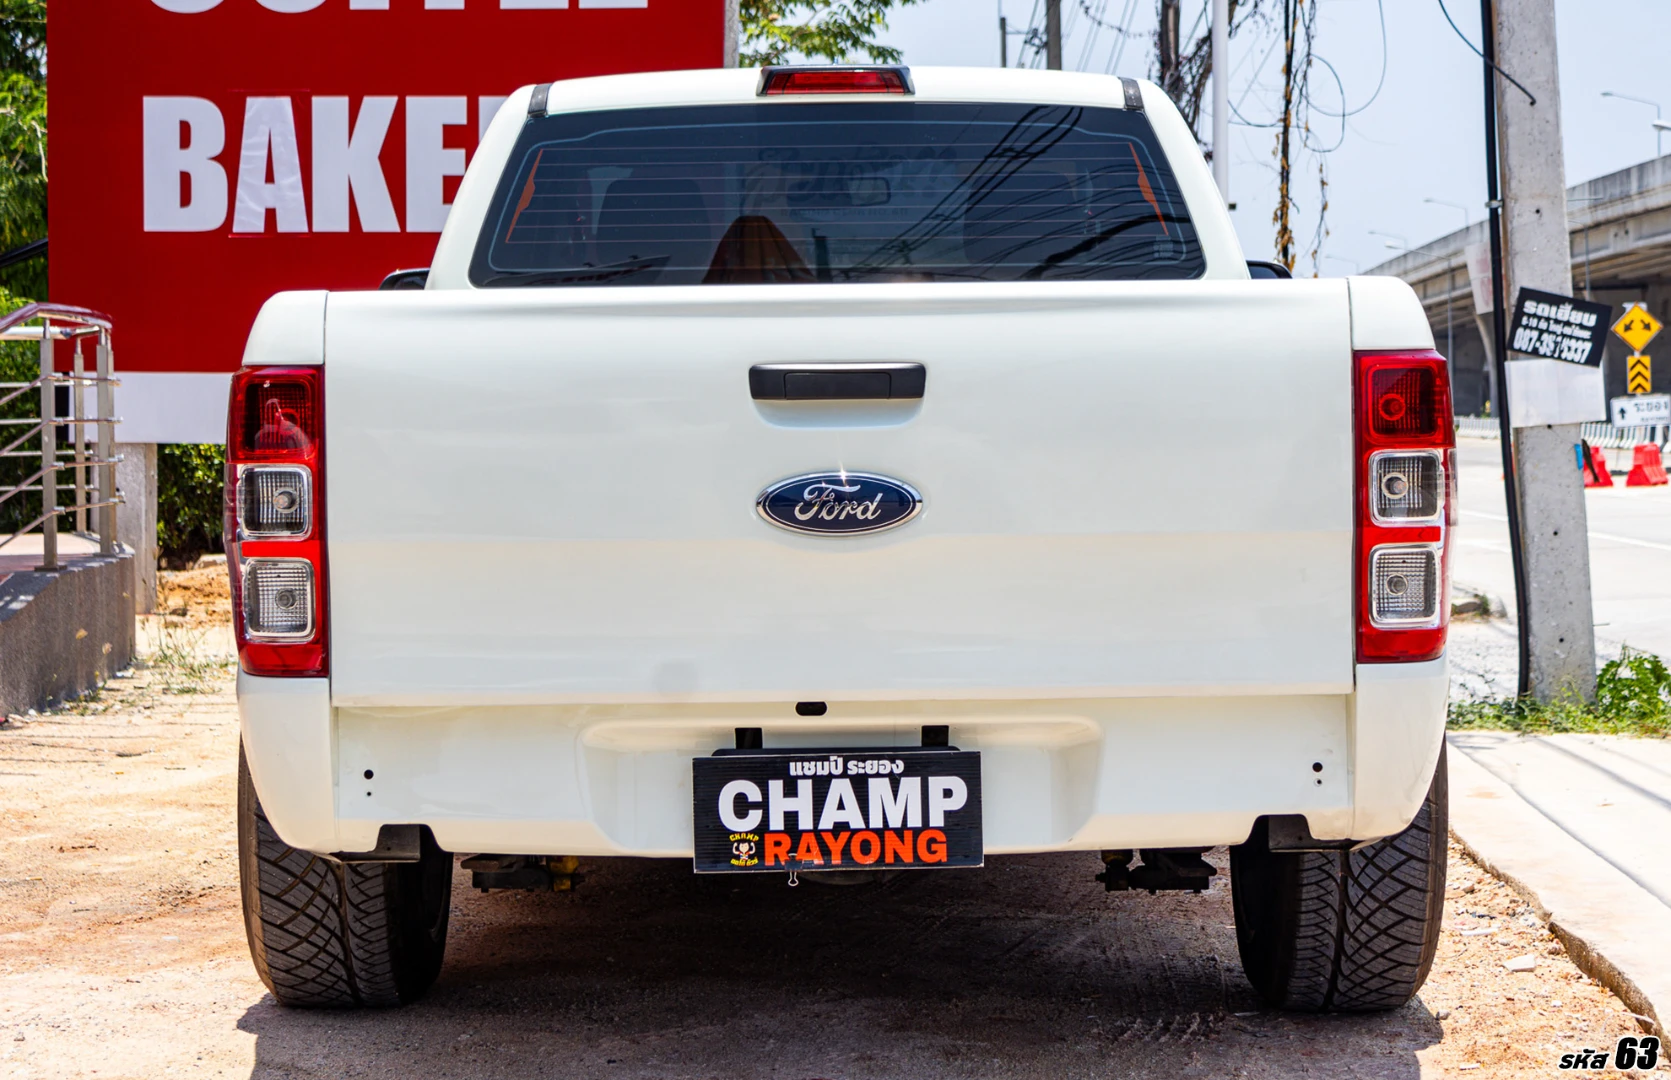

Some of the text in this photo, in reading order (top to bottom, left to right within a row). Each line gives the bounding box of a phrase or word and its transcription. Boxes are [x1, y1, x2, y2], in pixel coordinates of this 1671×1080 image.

[143, 95, 508, 233] BAKE
[794, 483, 883, 520] Ford
[847, 760, 905, 775] ระยอง
[718, 776, 968, 832] CHAMP
[729, 832, 760, 841] CHAMP
[764, 829, 948, 866] RAYONG
